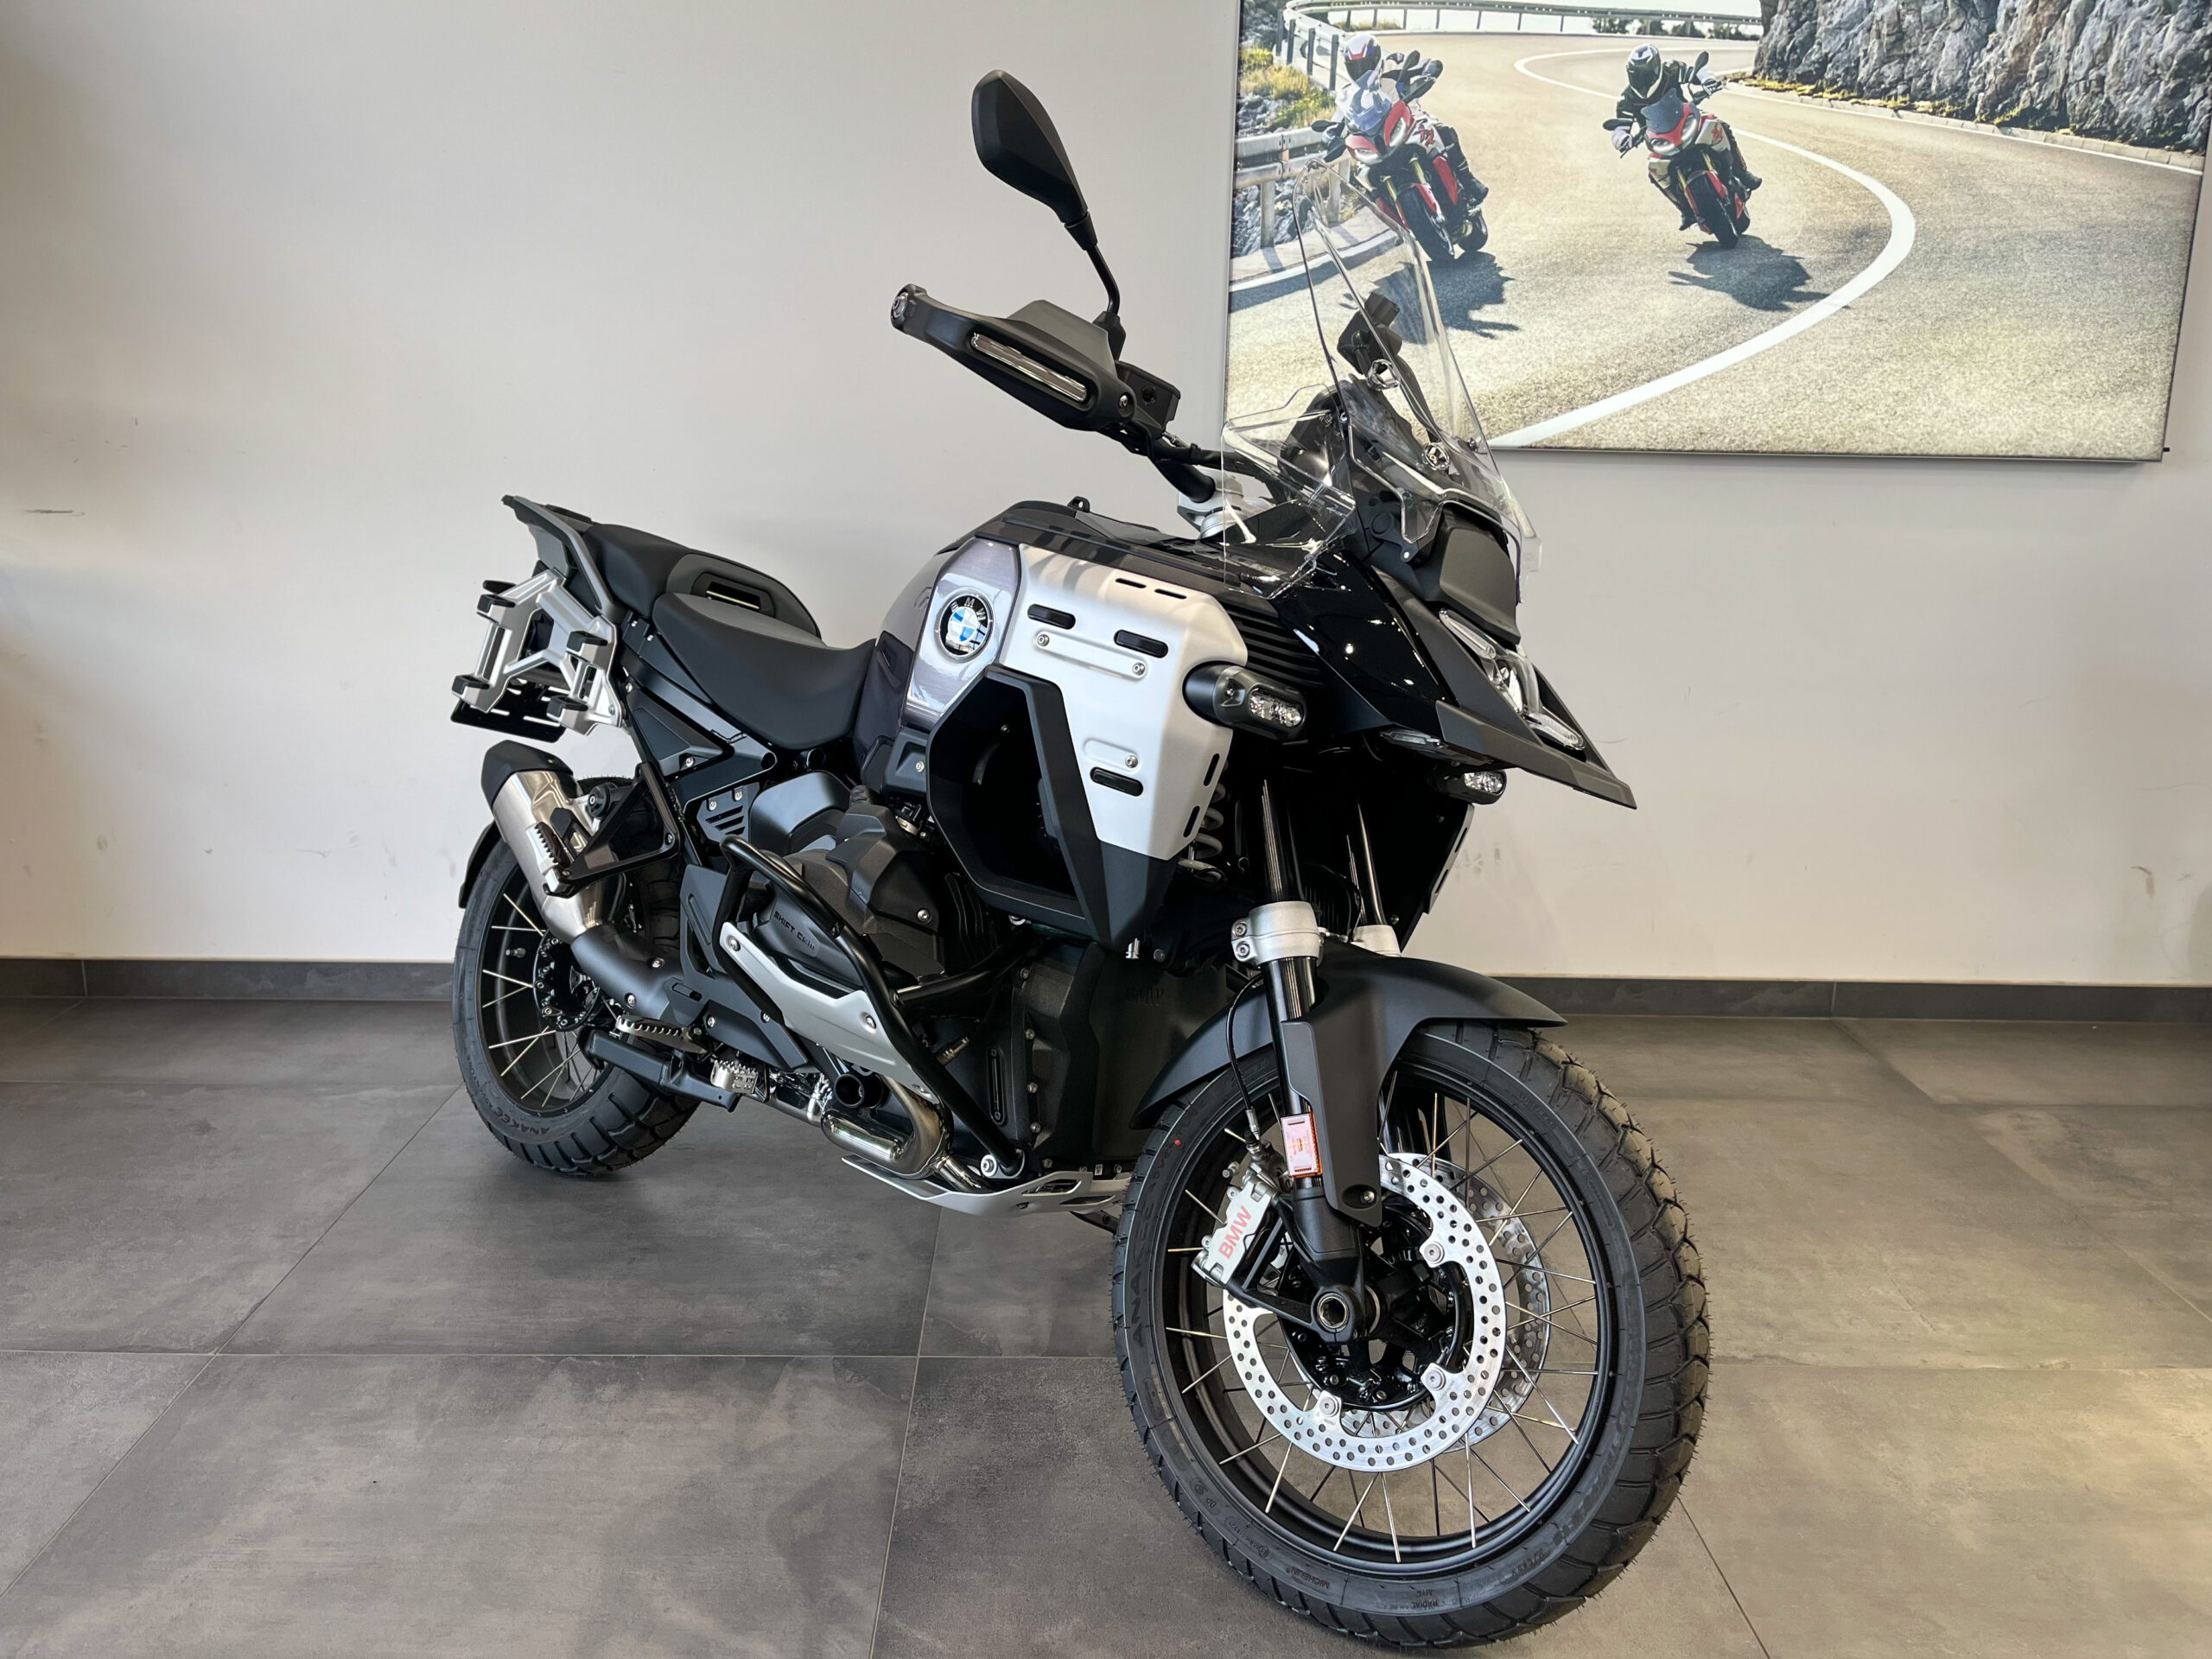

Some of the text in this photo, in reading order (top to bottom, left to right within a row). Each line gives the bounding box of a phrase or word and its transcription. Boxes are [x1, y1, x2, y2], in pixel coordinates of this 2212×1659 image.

[950, 597, 987, 621] BMW
[493, 1107, 550, 1135] ANAKEE
[1218, 1205, 1252, 1260] BMW
[1130, 1201, 1153, 1348] ANAKEE
